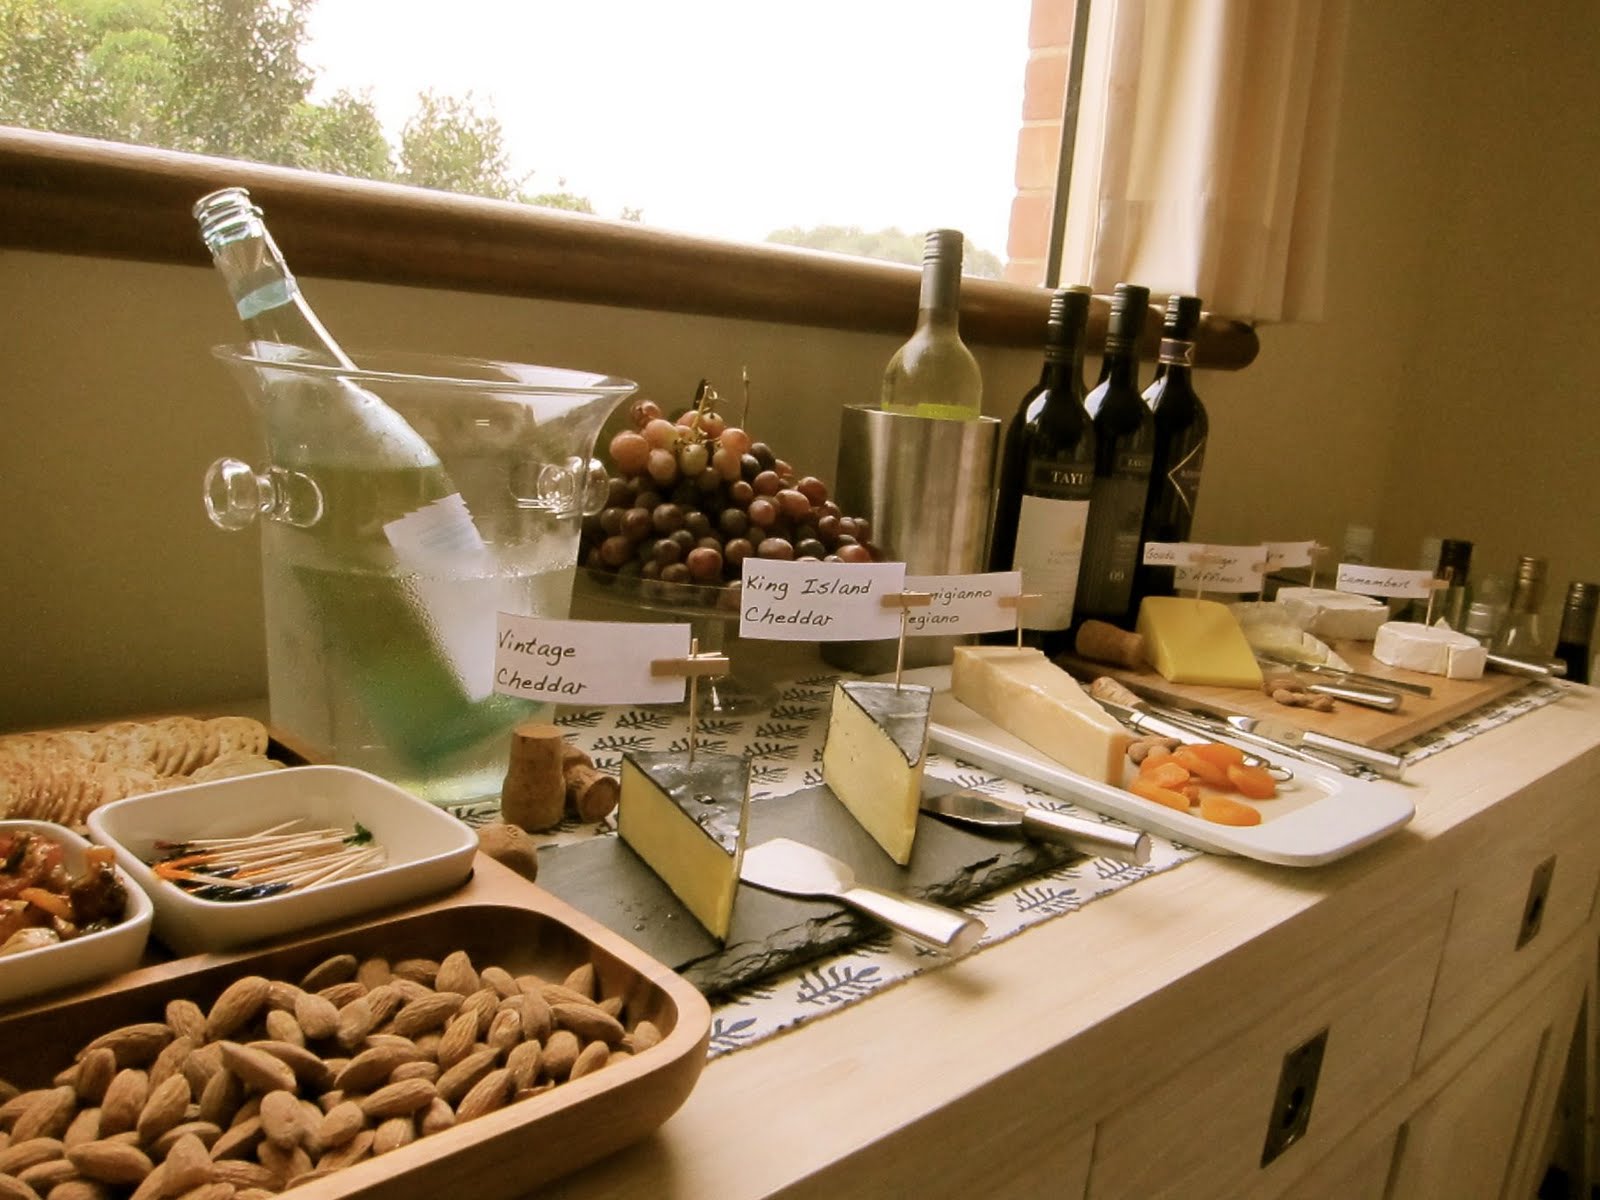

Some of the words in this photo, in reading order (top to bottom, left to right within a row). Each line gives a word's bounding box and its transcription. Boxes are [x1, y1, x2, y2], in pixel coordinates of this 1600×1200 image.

[746, 575, 789, 600] King
[800, 578, 872, 595] Island
[1341, 573, 1411, 589] Camembert
[744, 607, 834, 627] Cheddar
[499, 629, 577, 667] Vintage
[497, 668, 588, 695] Cheddar
